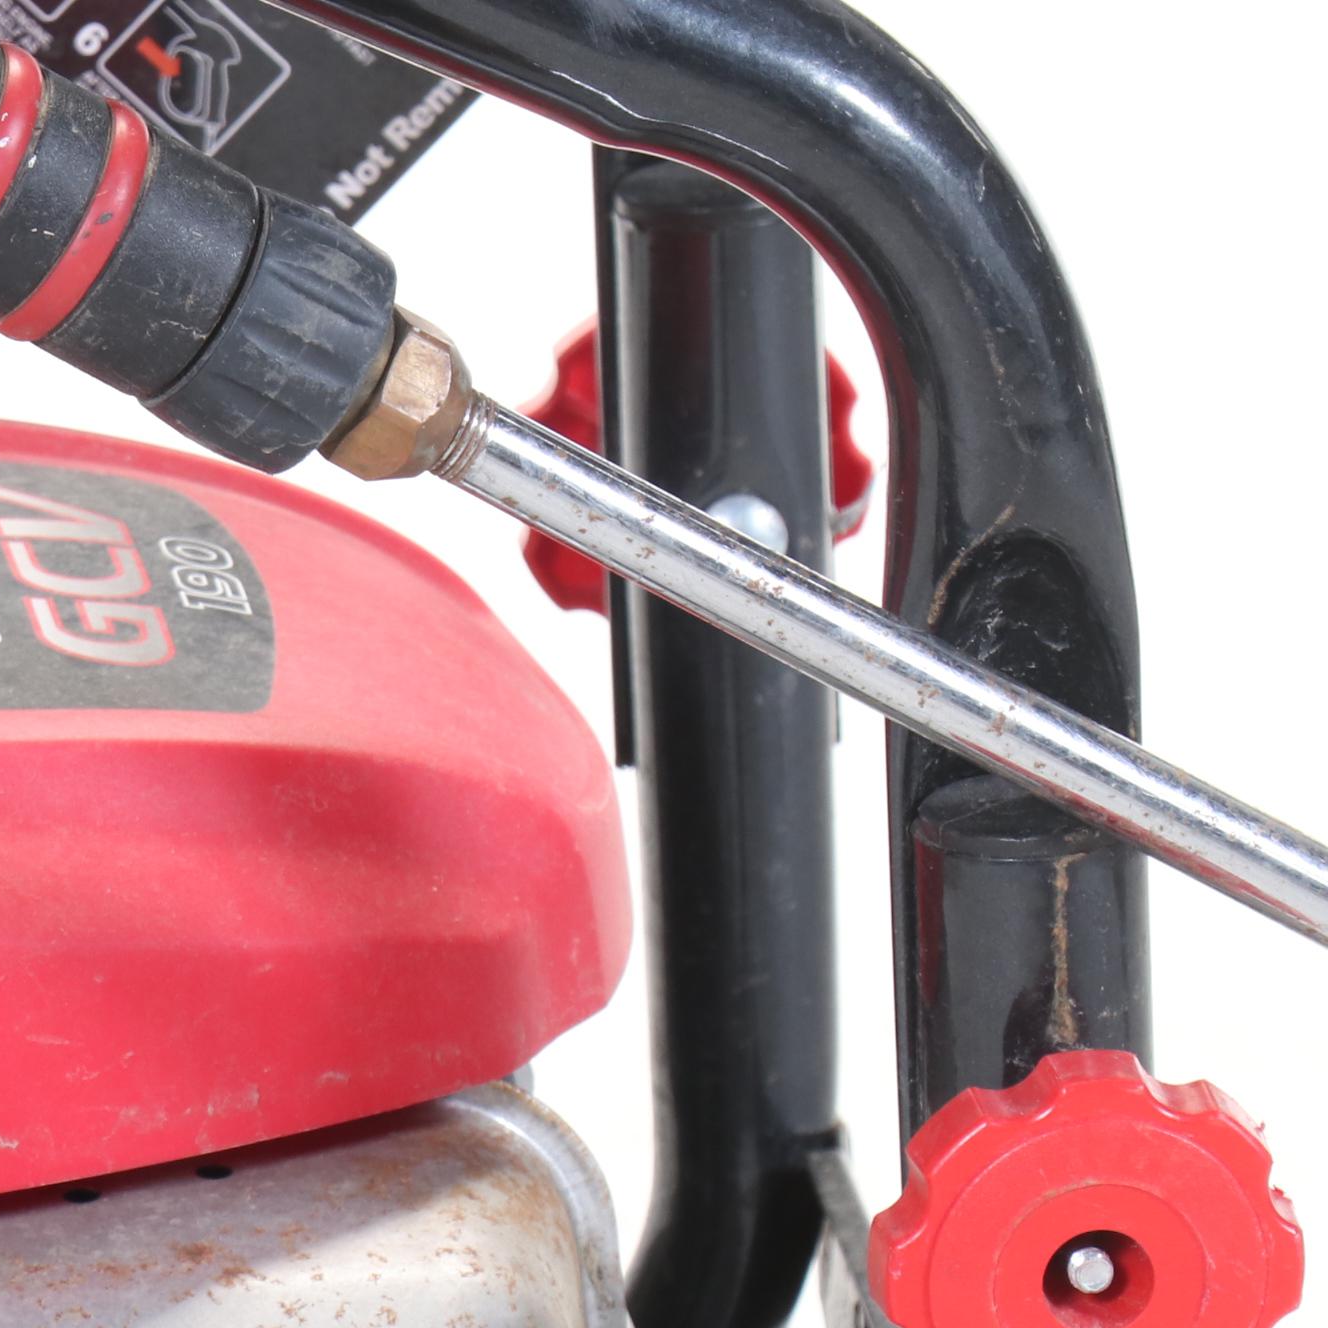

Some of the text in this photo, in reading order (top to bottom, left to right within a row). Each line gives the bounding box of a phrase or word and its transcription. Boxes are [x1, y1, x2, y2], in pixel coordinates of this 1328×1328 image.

[73, 21, 110, 56] 6
[325, 142, 395, 211] Not
[158, 536, 253, 616] 190
